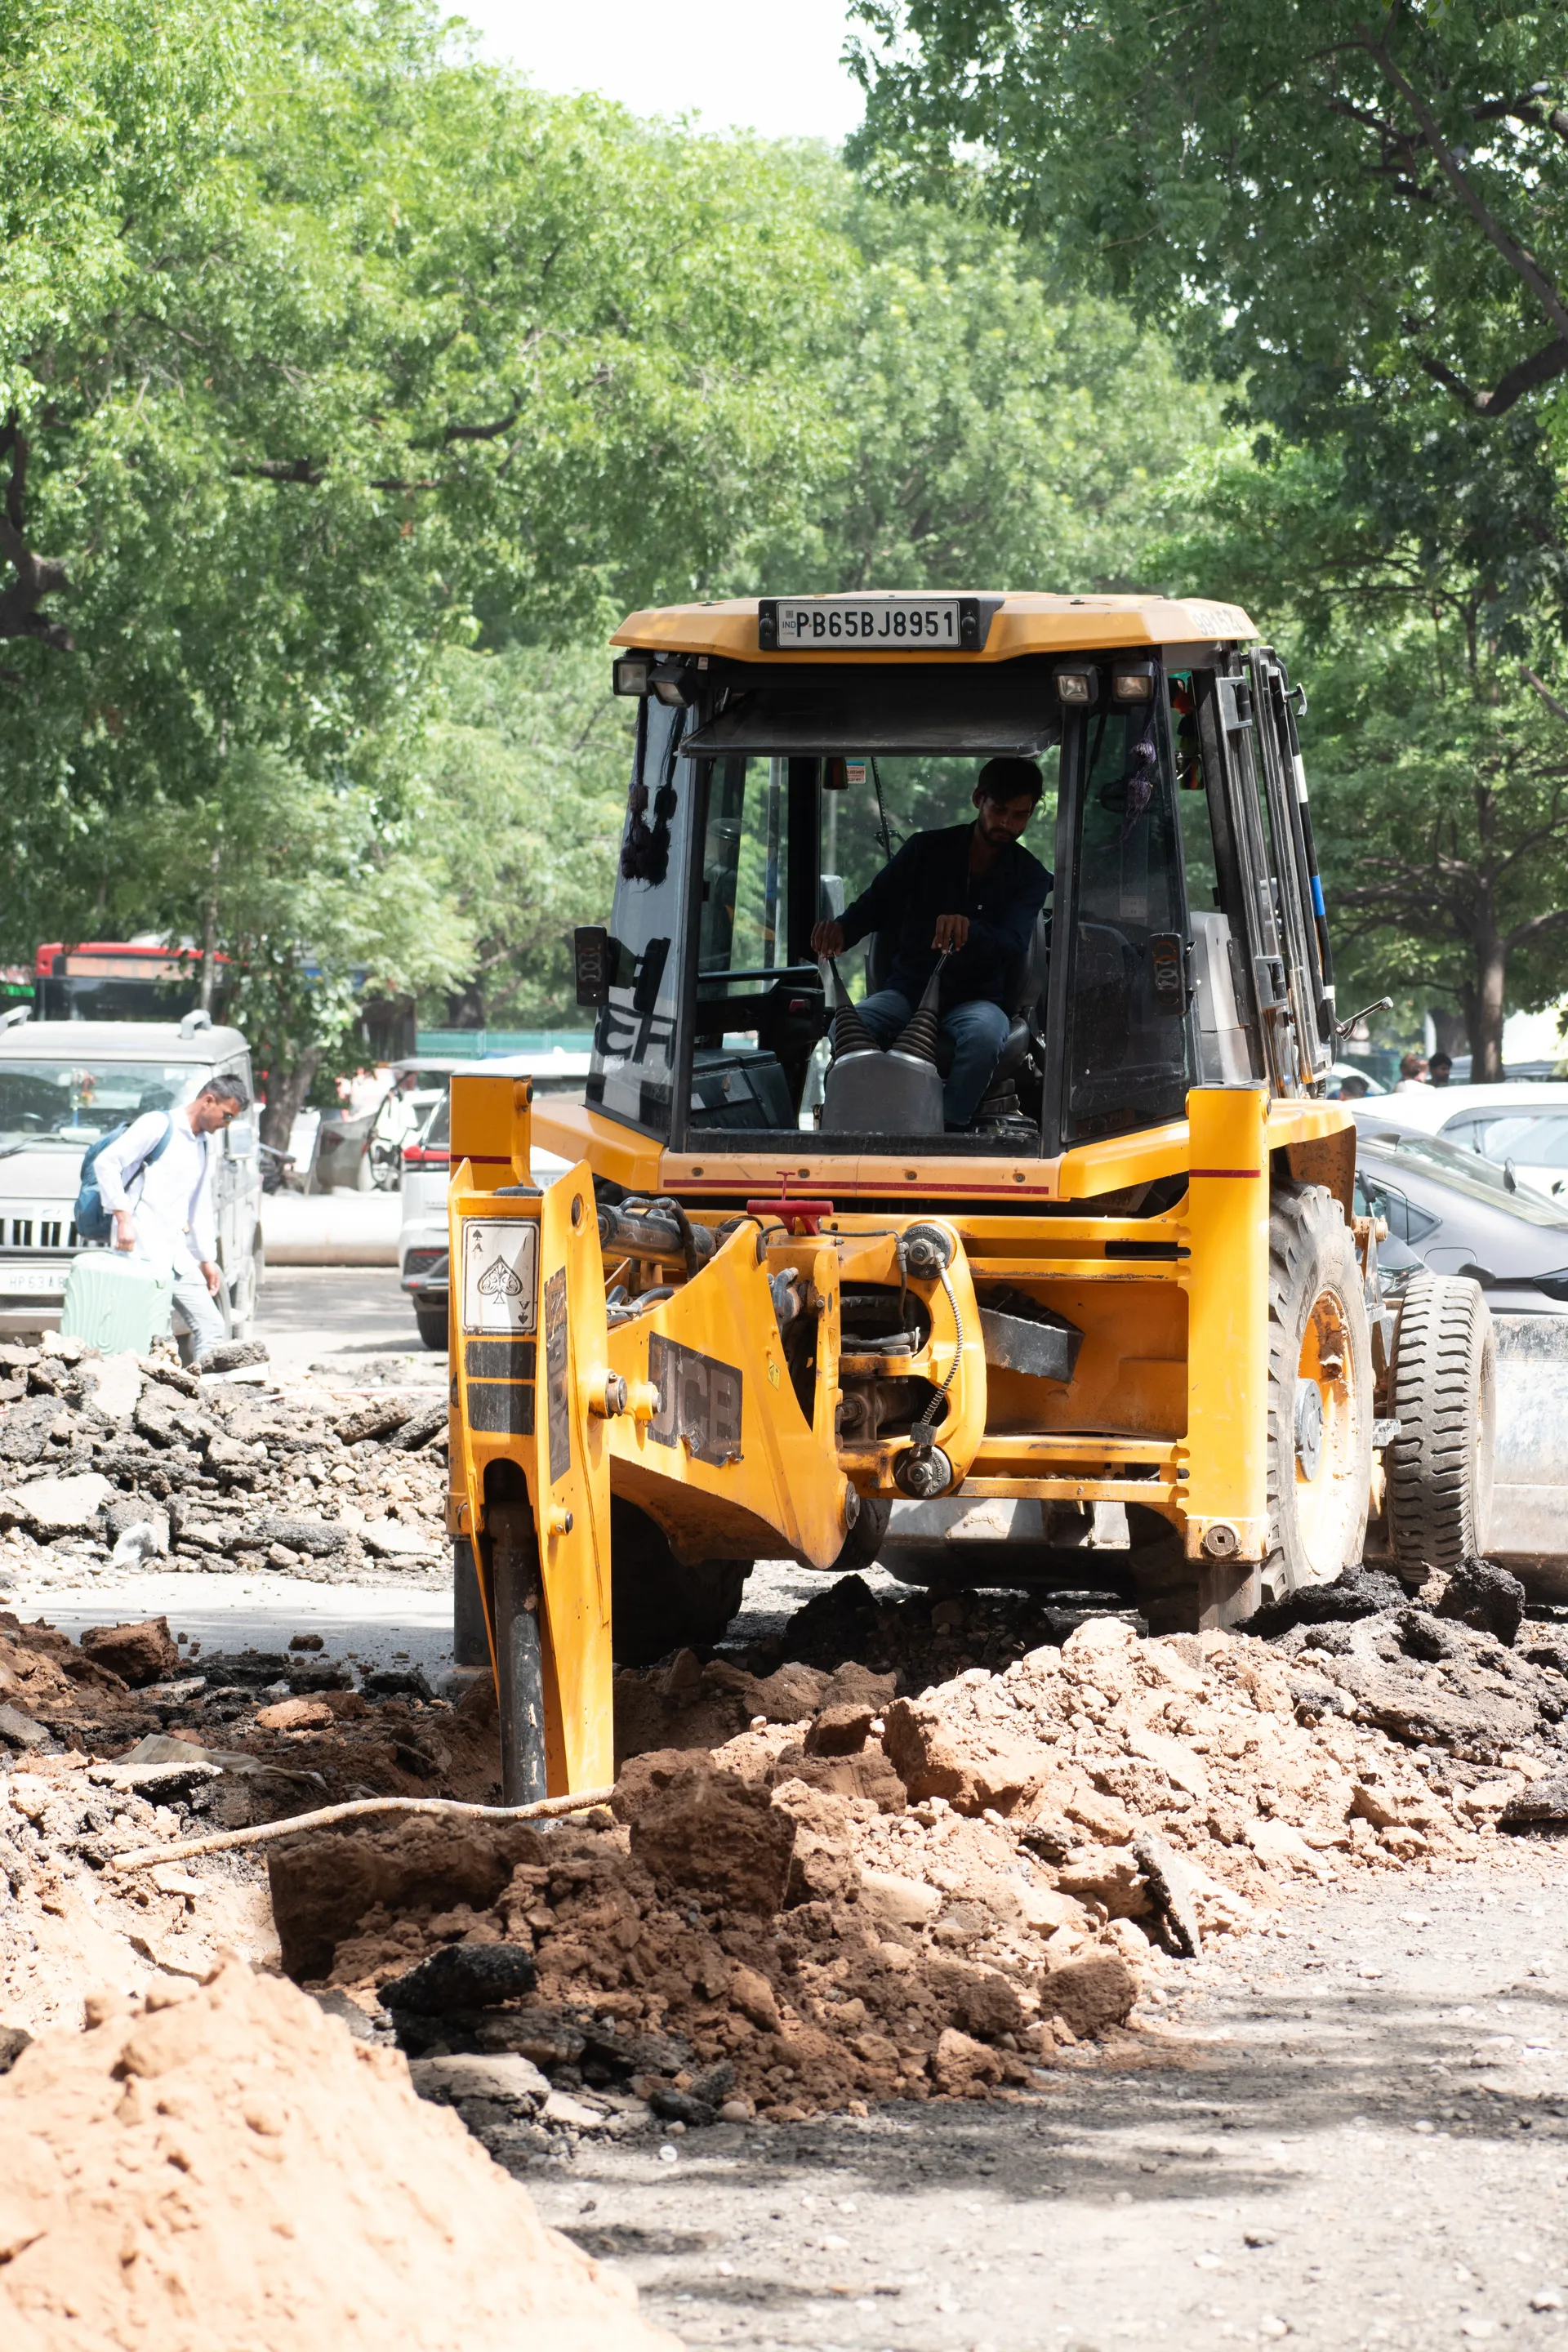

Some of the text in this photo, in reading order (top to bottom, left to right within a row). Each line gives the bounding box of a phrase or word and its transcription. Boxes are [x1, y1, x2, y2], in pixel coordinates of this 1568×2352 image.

[782, 621, 796, 629] IND
[797, 611, 952, 637] PB65BJ8951
[653, 1349, 740, 1456] JCB
